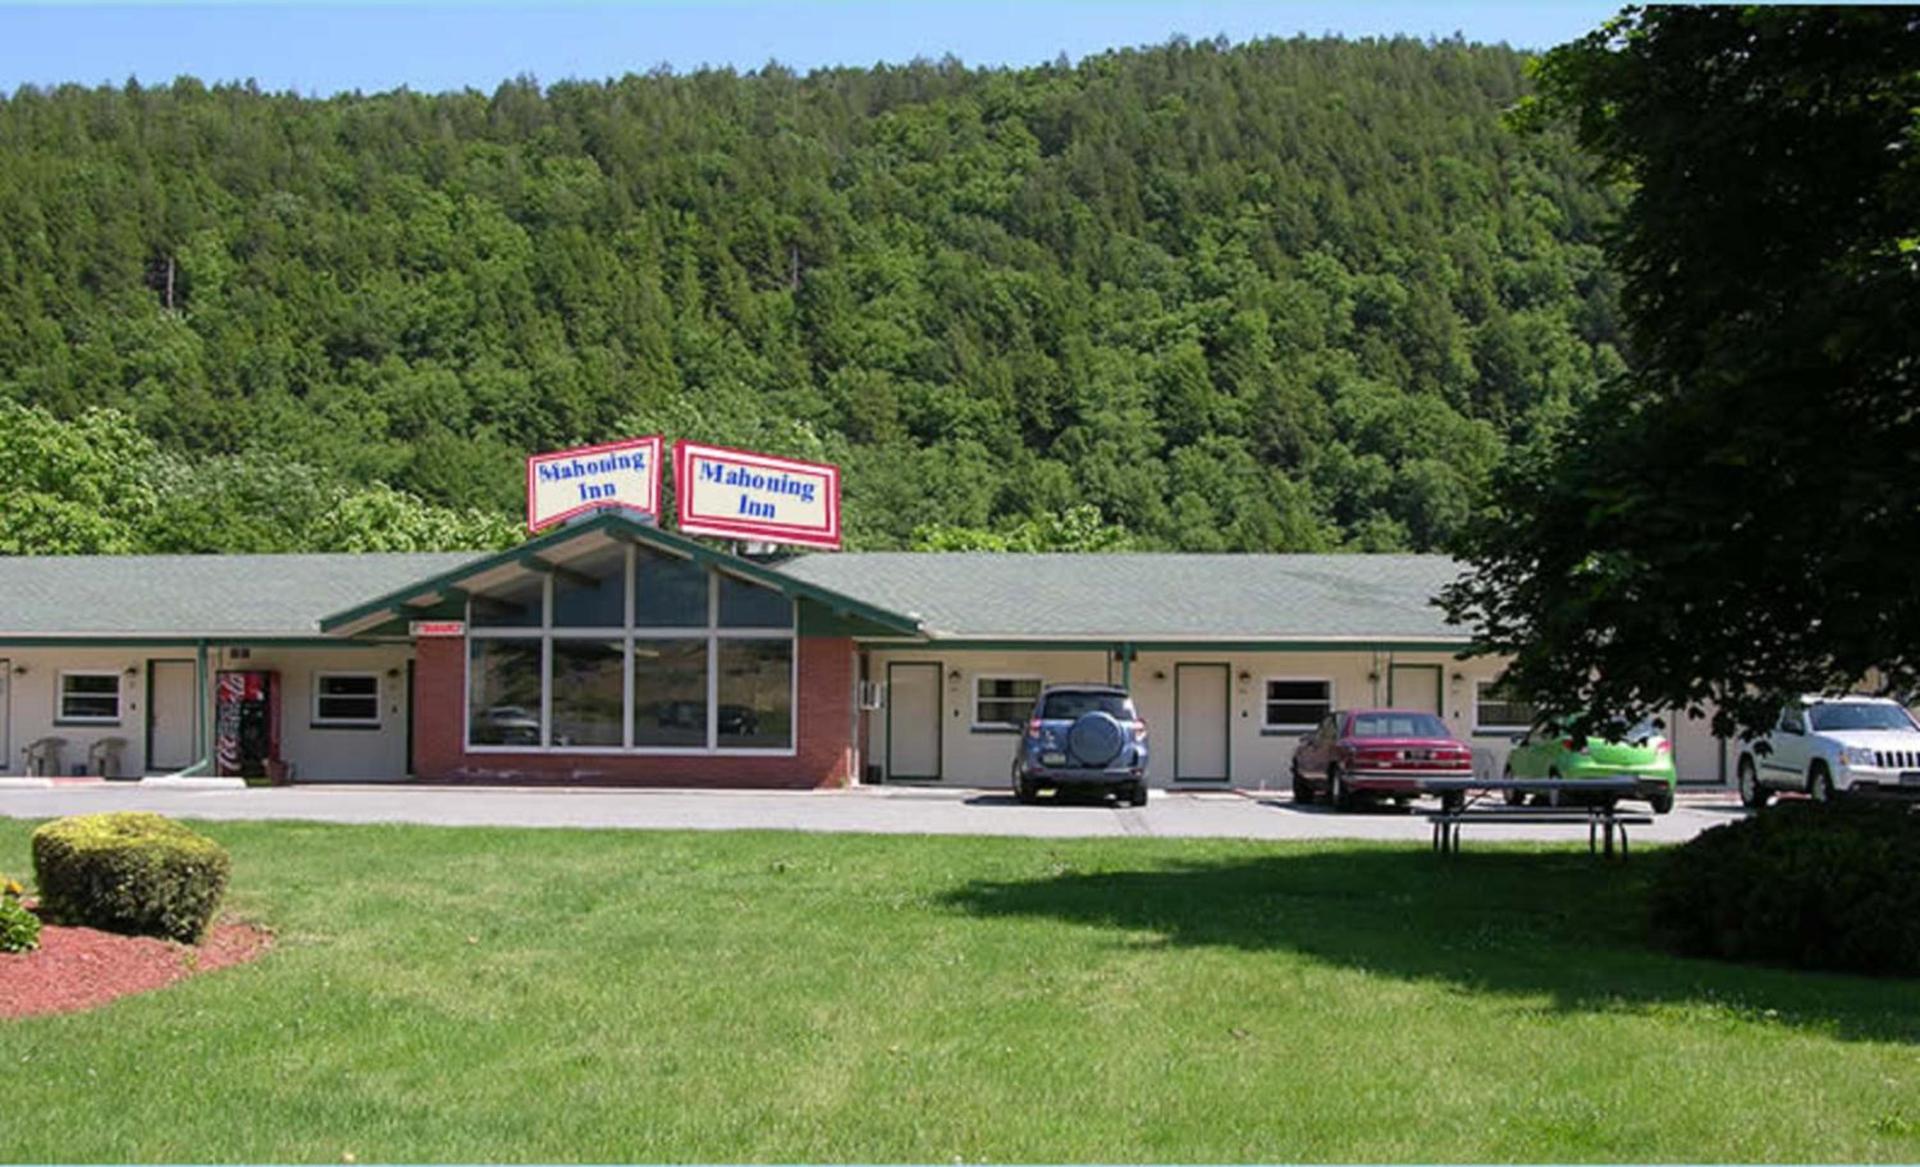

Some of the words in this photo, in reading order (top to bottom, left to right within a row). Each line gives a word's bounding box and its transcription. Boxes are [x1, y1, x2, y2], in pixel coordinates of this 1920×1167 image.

[538, 451, 647, 483] Mahoning
[698, 460, 816, 502] Mahoning
[577, 480, 616, 501] Inn
[737, 495, 777, 519] Inn
